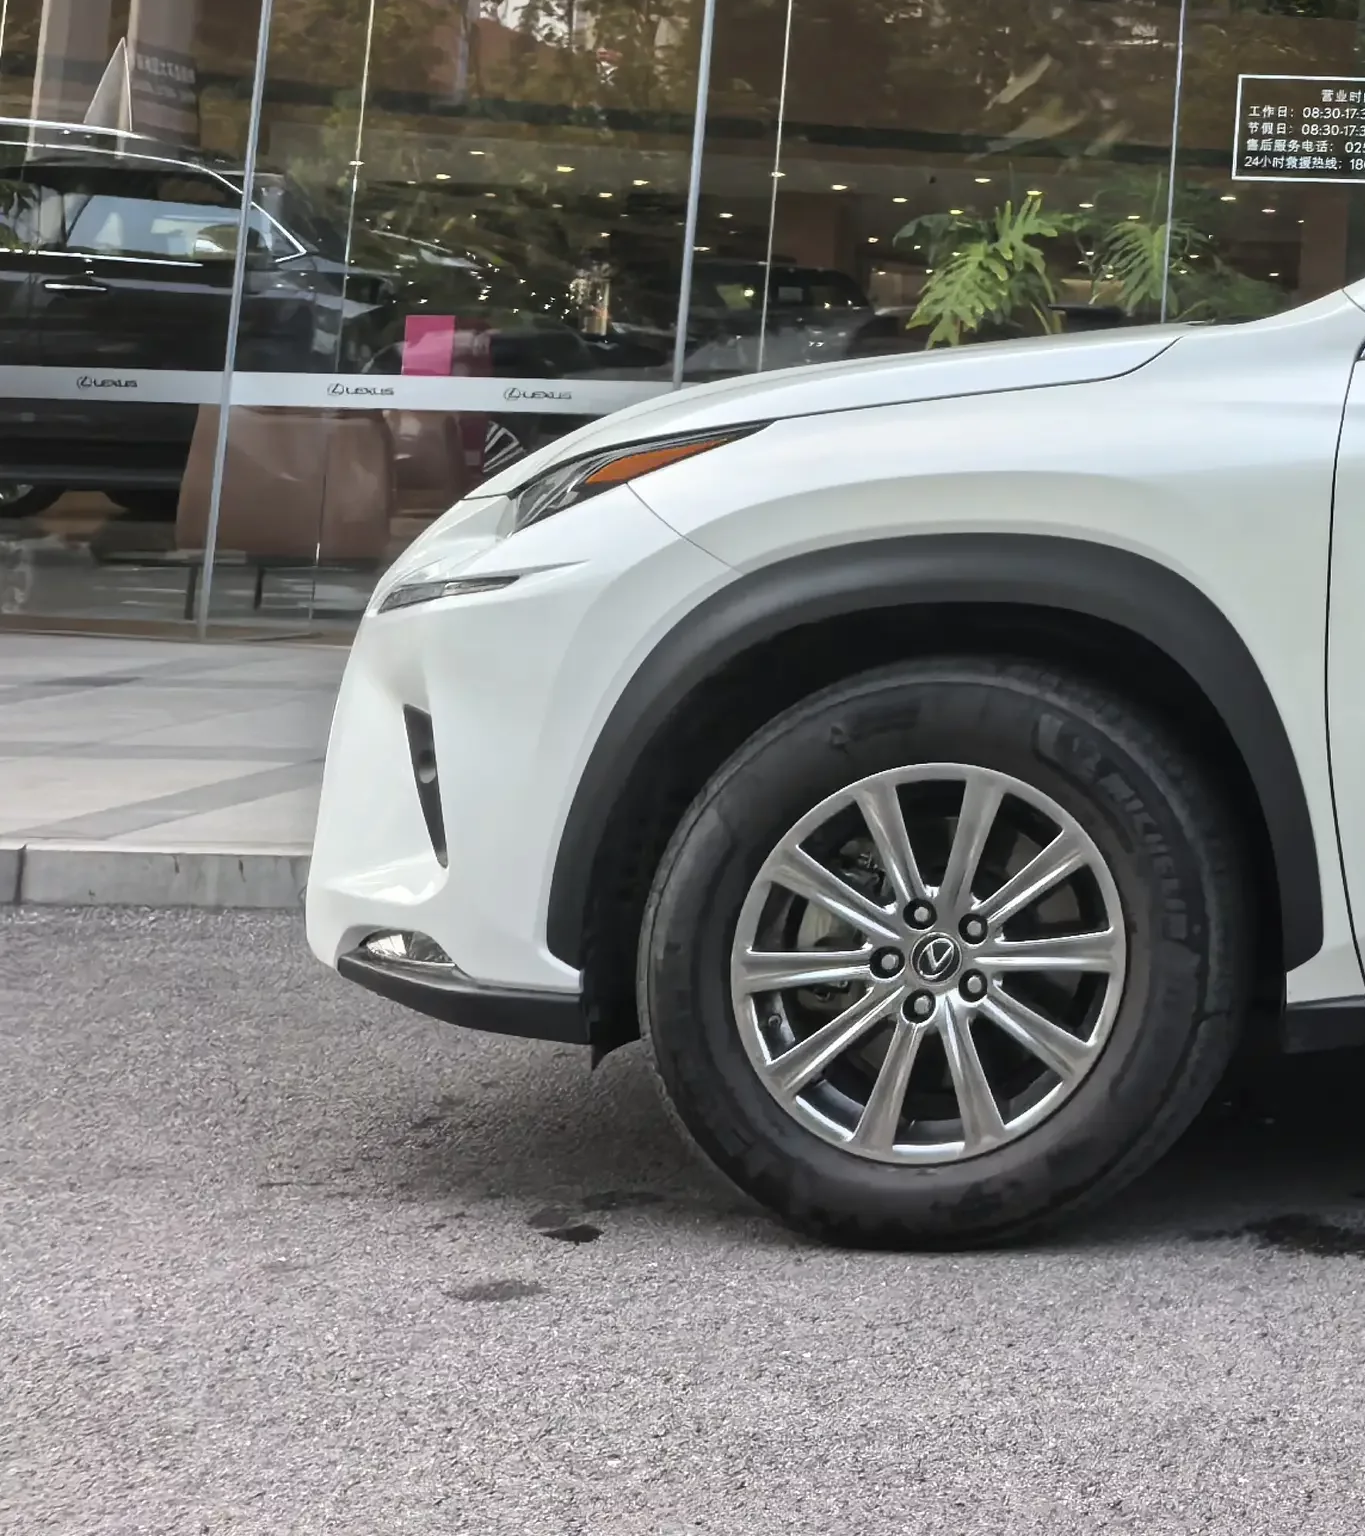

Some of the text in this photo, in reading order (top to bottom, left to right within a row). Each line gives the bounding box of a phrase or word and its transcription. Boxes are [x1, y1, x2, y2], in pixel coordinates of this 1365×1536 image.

[1248, 105, 1295, 119] 工作日：
[1247, 122, 1294, 135] 节假日：
[1246, 139, 1334, 153] 售后服务电话：
